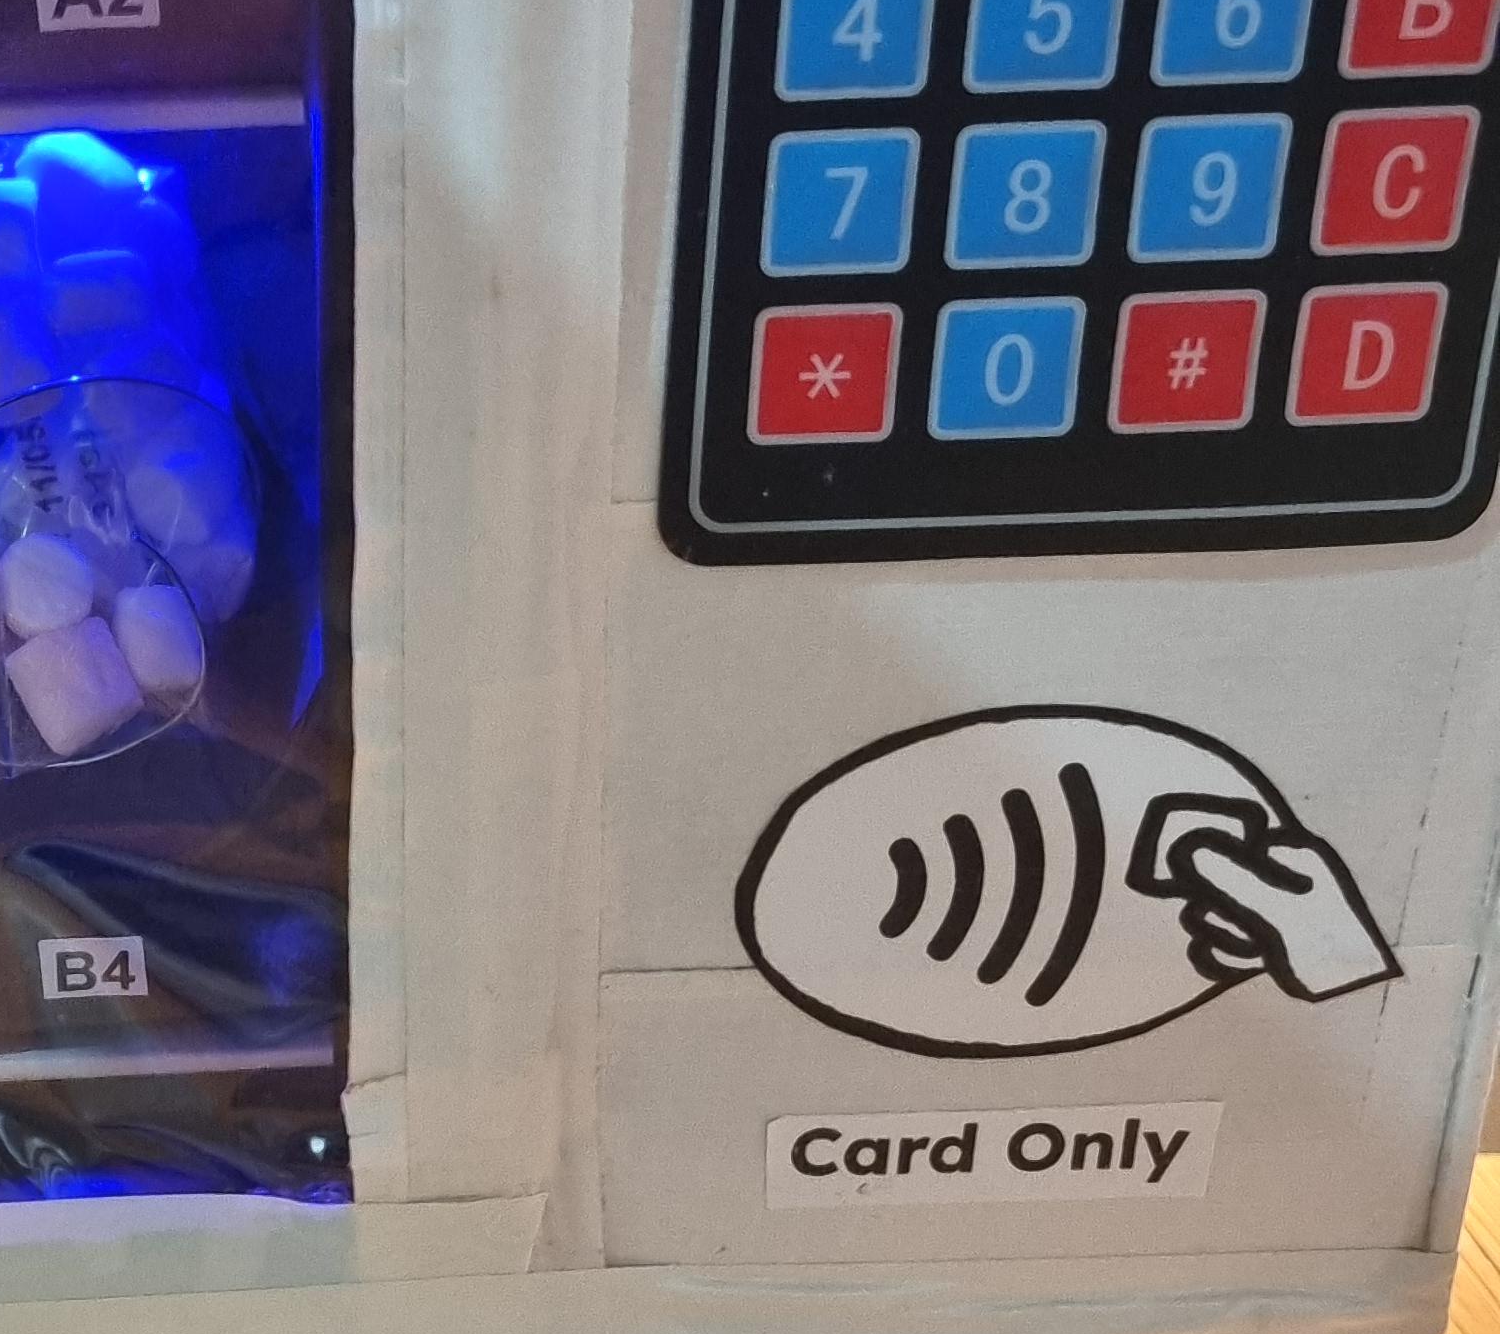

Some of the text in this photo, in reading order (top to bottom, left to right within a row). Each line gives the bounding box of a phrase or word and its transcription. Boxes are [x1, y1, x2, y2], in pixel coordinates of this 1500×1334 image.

[822, 144, 1425, 242] 7 8 9 C
[985, 332, 1034, 407] 0
[1167, 336, 1208, 391] #
[1341, 318, 1395, 394] D
[56, 949, 136, 993] B4
[790, 1117, 1191, 1185] Card Only
